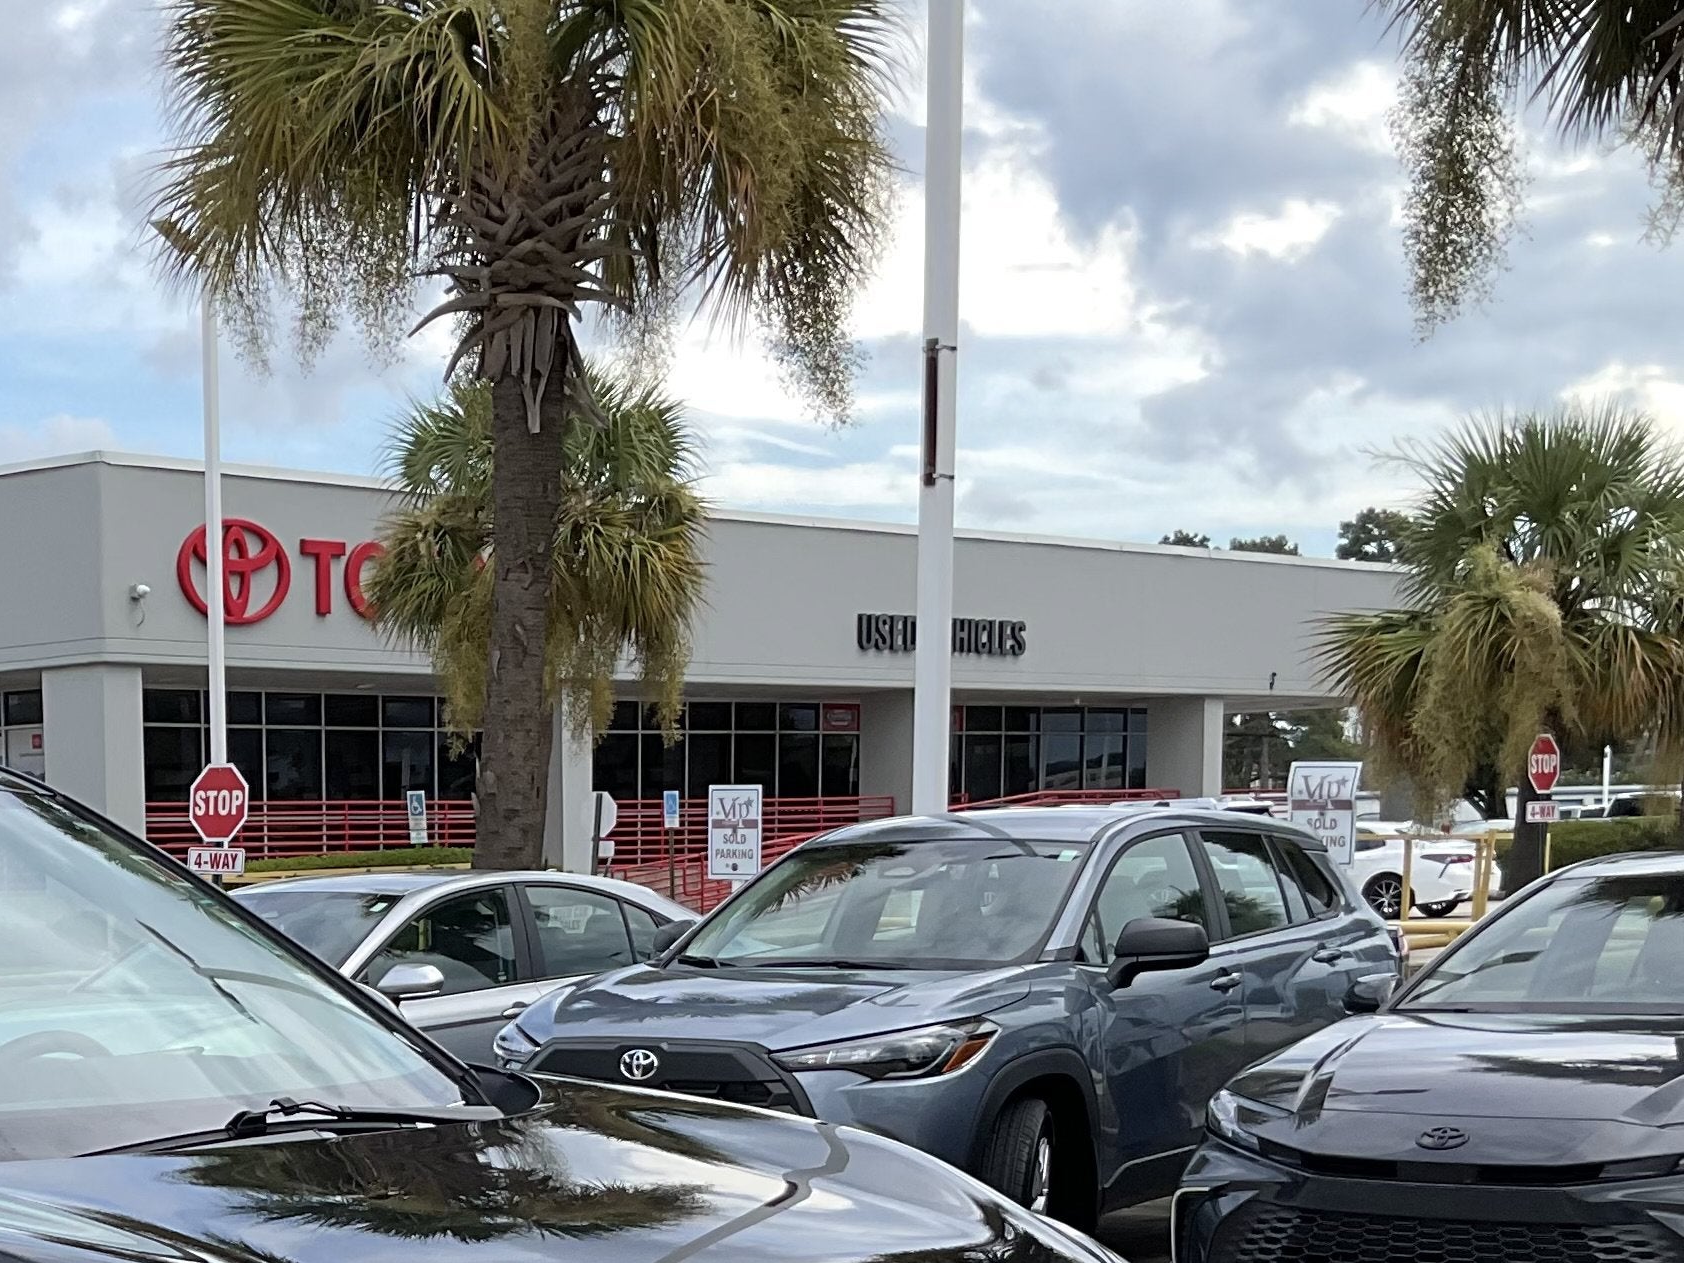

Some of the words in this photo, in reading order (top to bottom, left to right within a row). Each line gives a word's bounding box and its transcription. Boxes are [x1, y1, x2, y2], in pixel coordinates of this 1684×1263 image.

[952, 617, 1027, 656] HICLES
[1531, 754, 1557, 774] STOP
[194, 789, 244, 816] STOP
[1530, 805, 1556, 818] 4-WAY
[723, 833, 747, 845] SOLD
[194, 853, 238, 870] 4-WAY
[715, 848, 754, 860] PARKING
